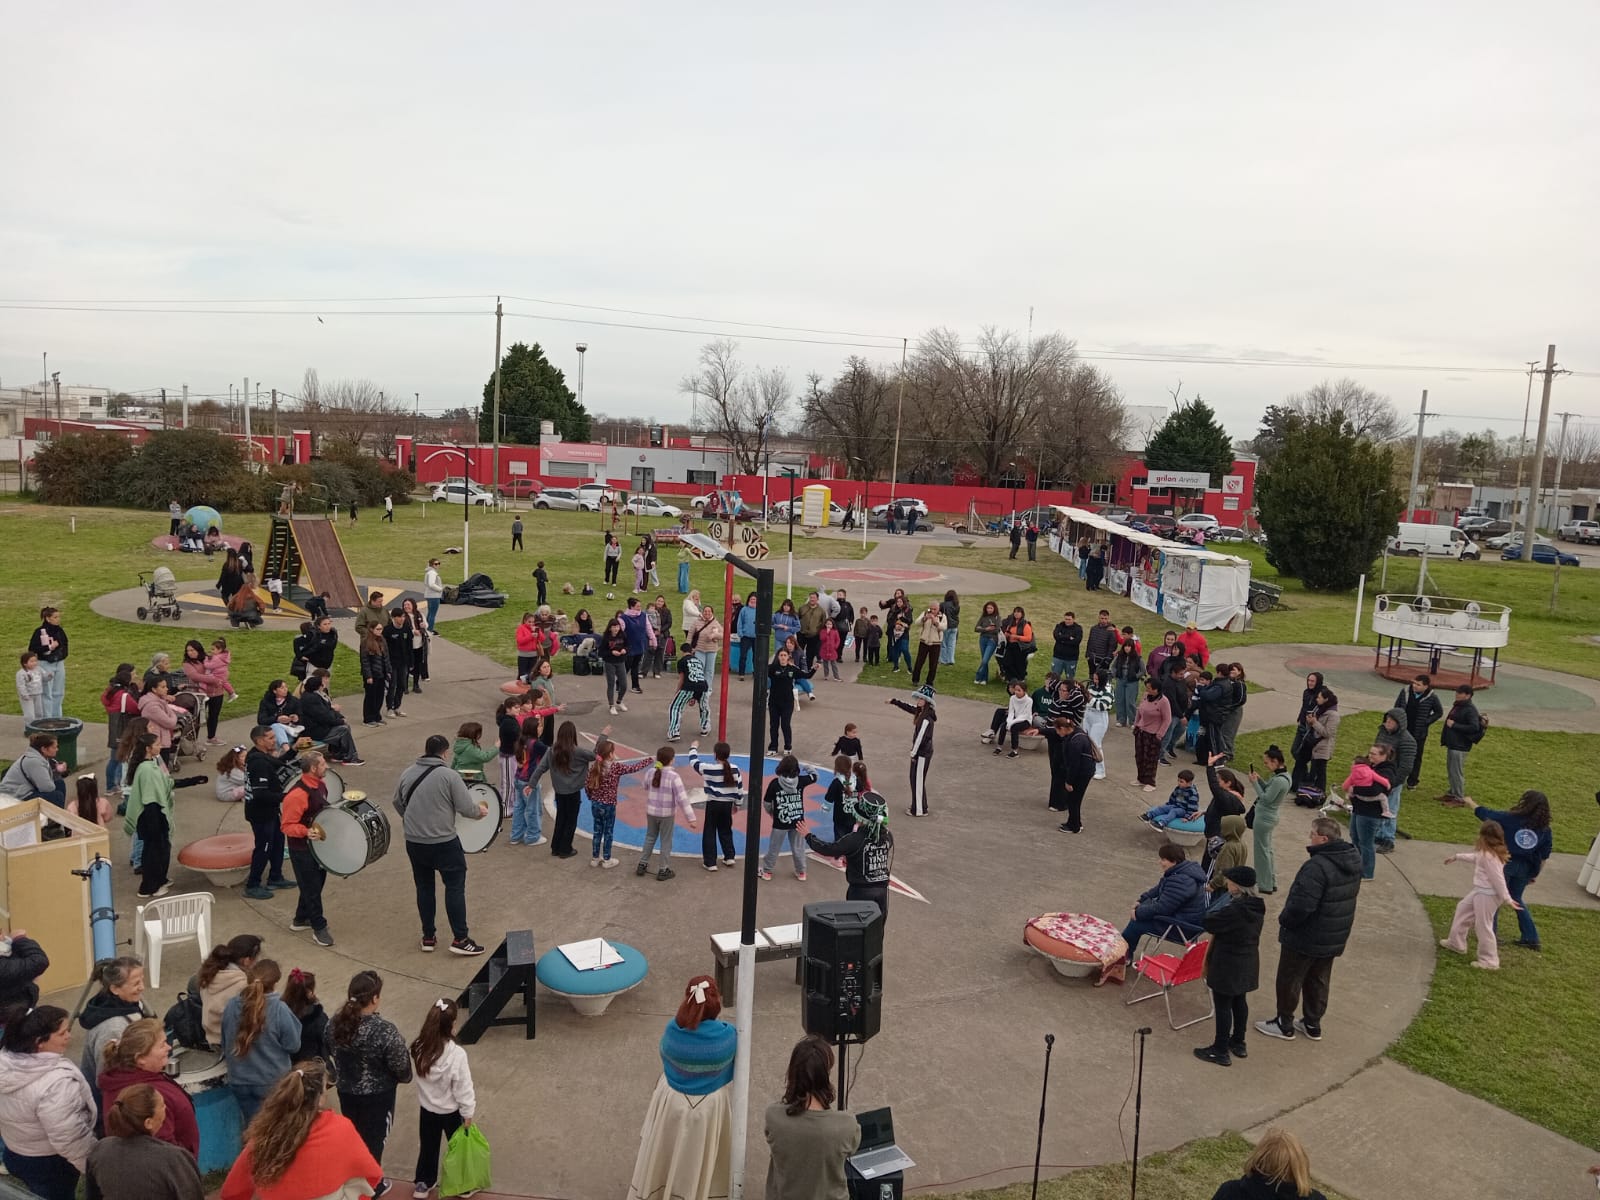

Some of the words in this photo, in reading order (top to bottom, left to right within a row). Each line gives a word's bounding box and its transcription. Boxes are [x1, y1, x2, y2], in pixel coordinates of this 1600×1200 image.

[1156, 475, 1177, 483] grilon
[714, 523, 721, 538] S
[743, 528, 751, 542] N
[747, 545, 757, 558] O
